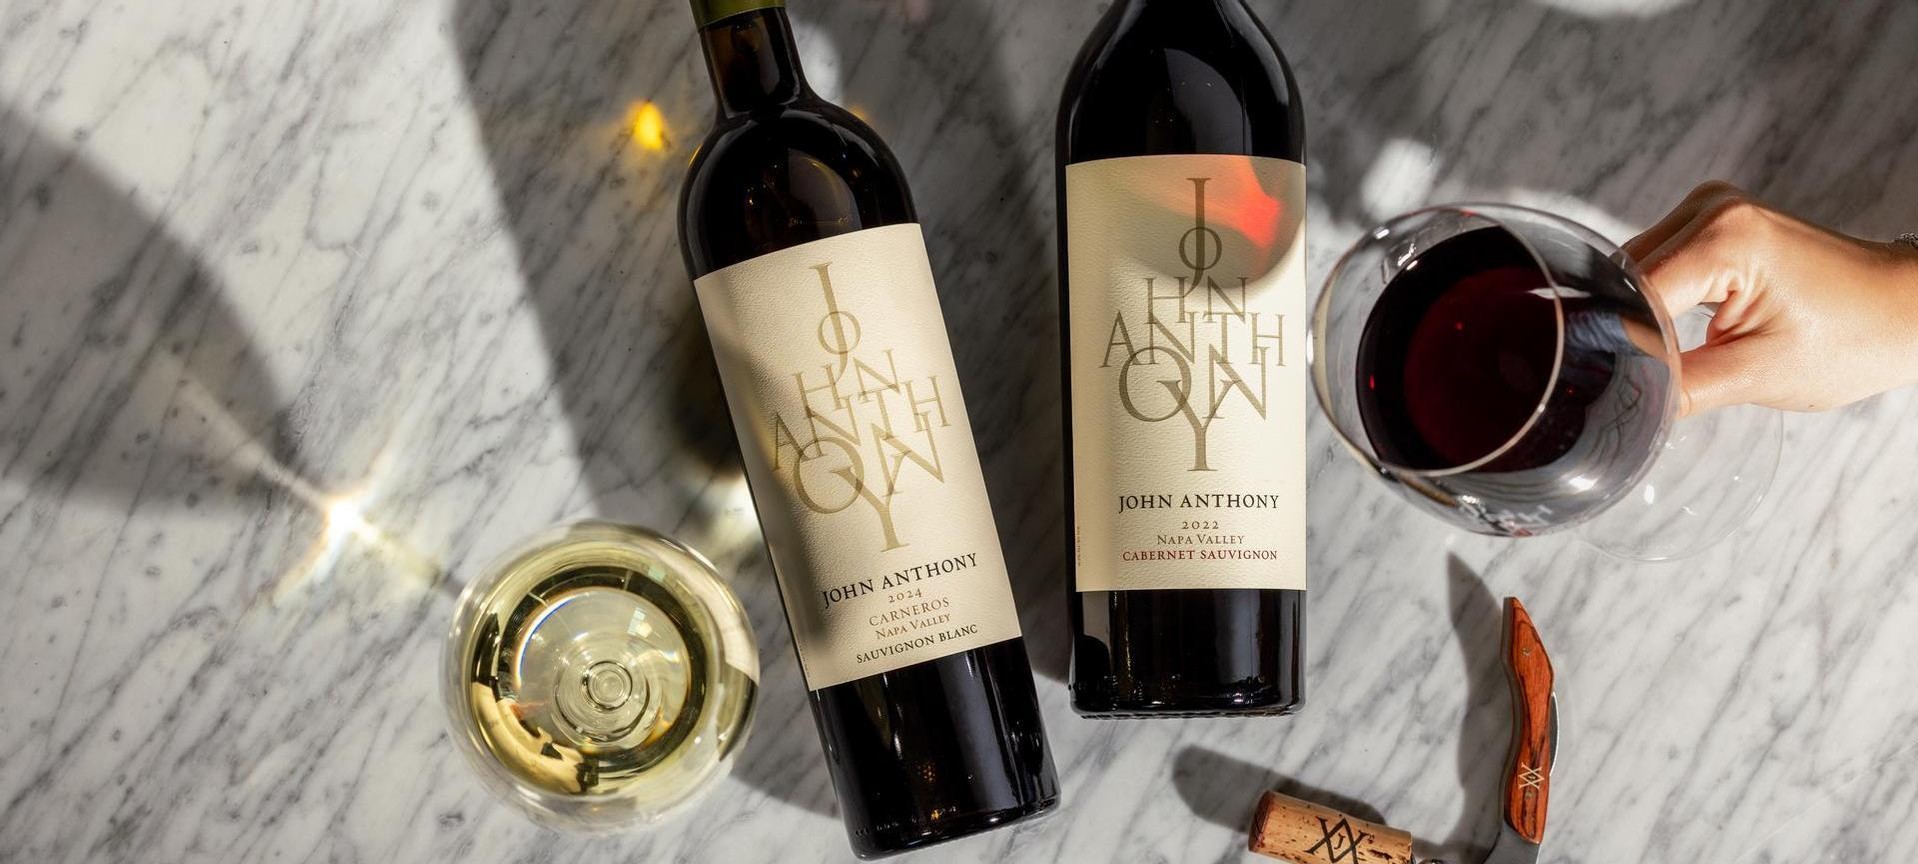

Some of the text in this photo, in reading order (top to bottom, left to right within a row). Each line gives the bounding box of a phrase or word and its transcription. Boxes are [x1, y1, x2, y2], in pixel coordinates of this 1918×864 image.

[1118, 493, 1280, 514] JOHN ANTHONY
[1181, 520, 1220, 530] 2022
[1157, 534, 1246, 545] NAPA VALLEY
[1122, 549, 1278, 562] CABERNET SAUVIGNON
[821, 552, 978, 609] JOHN ANTHONY
[887, 588, 923, 604] 2024
[868, 596, 950, 627] CARNEROS
[875, 613, 951, 640] NAPA VALLEY
[856, 624, 979, 664] SAUVIGNON BLANC
